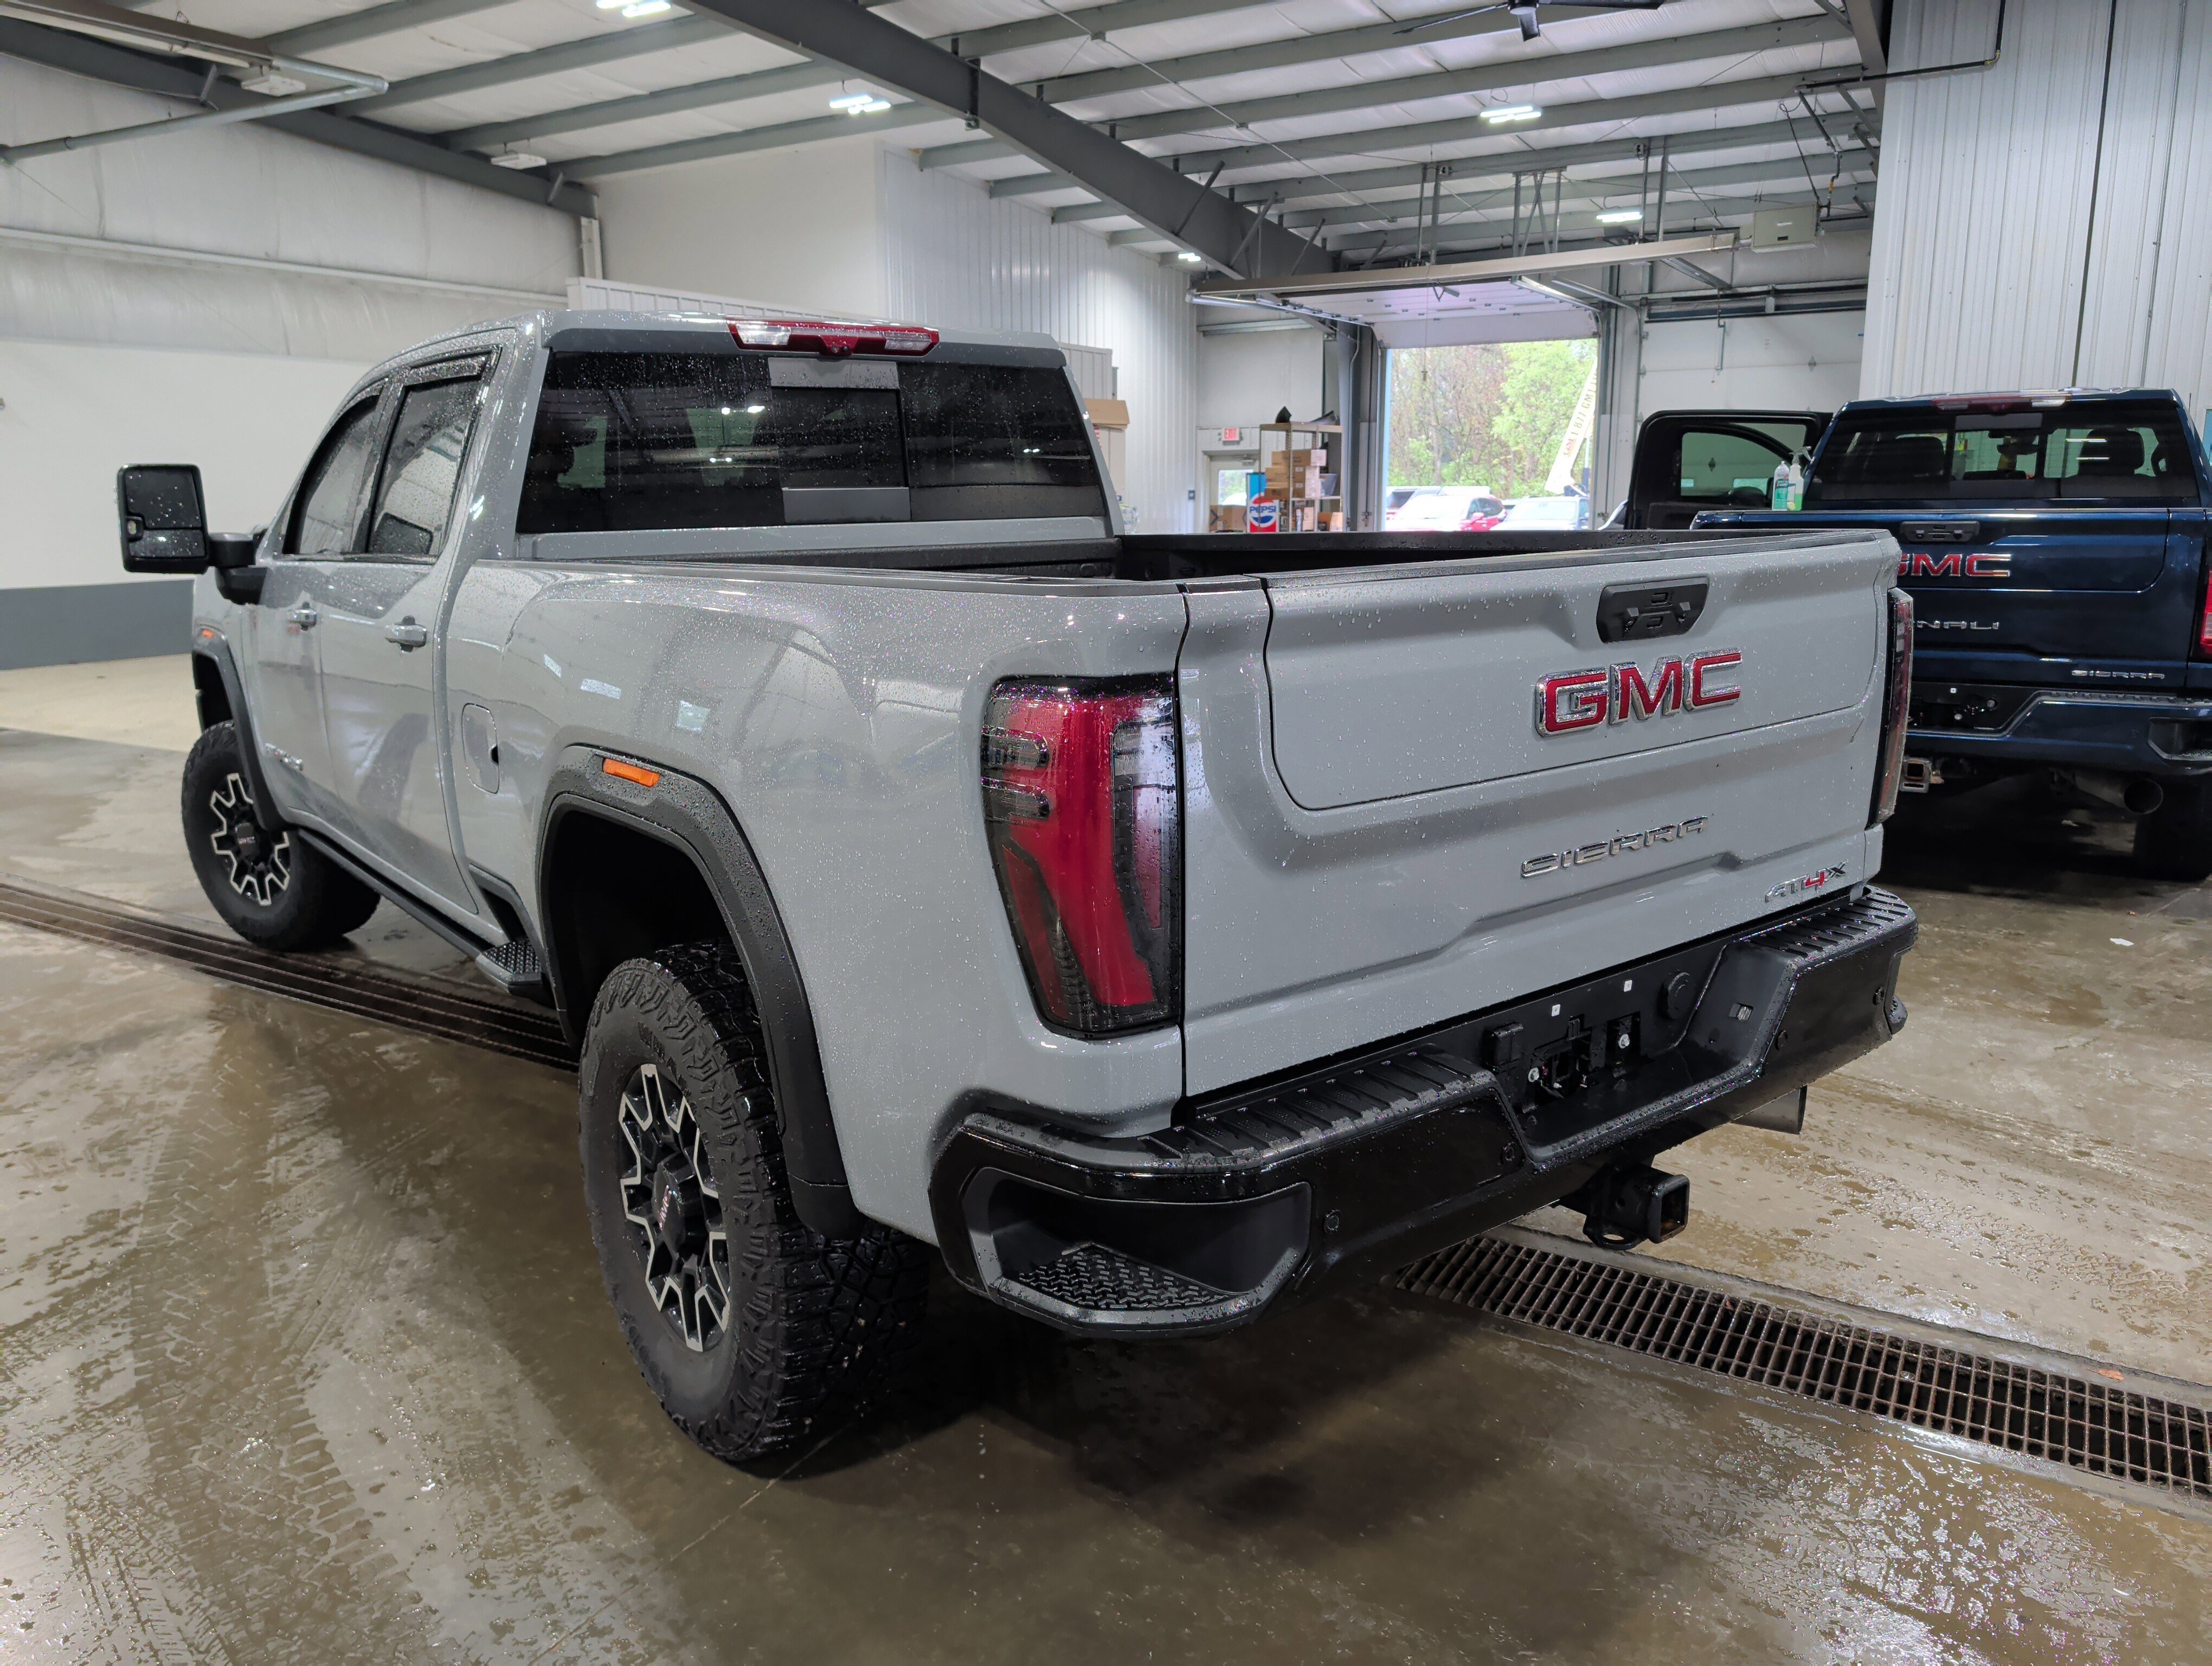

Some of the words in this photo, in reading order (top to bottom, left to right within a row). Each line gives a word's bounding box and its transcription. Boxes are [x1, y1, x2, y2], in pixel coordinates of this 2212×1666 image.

[1249, 505, 1276, 514] PEPSI
[1898, 553, 2012, 578] MC
[1917, 620, 1999, 630] NALI
[2071, 670, 2165, 680] SIERRA
[1535, 647, 1742, 738] GMC
[1520, 815, 1708, 879] SIERRA
